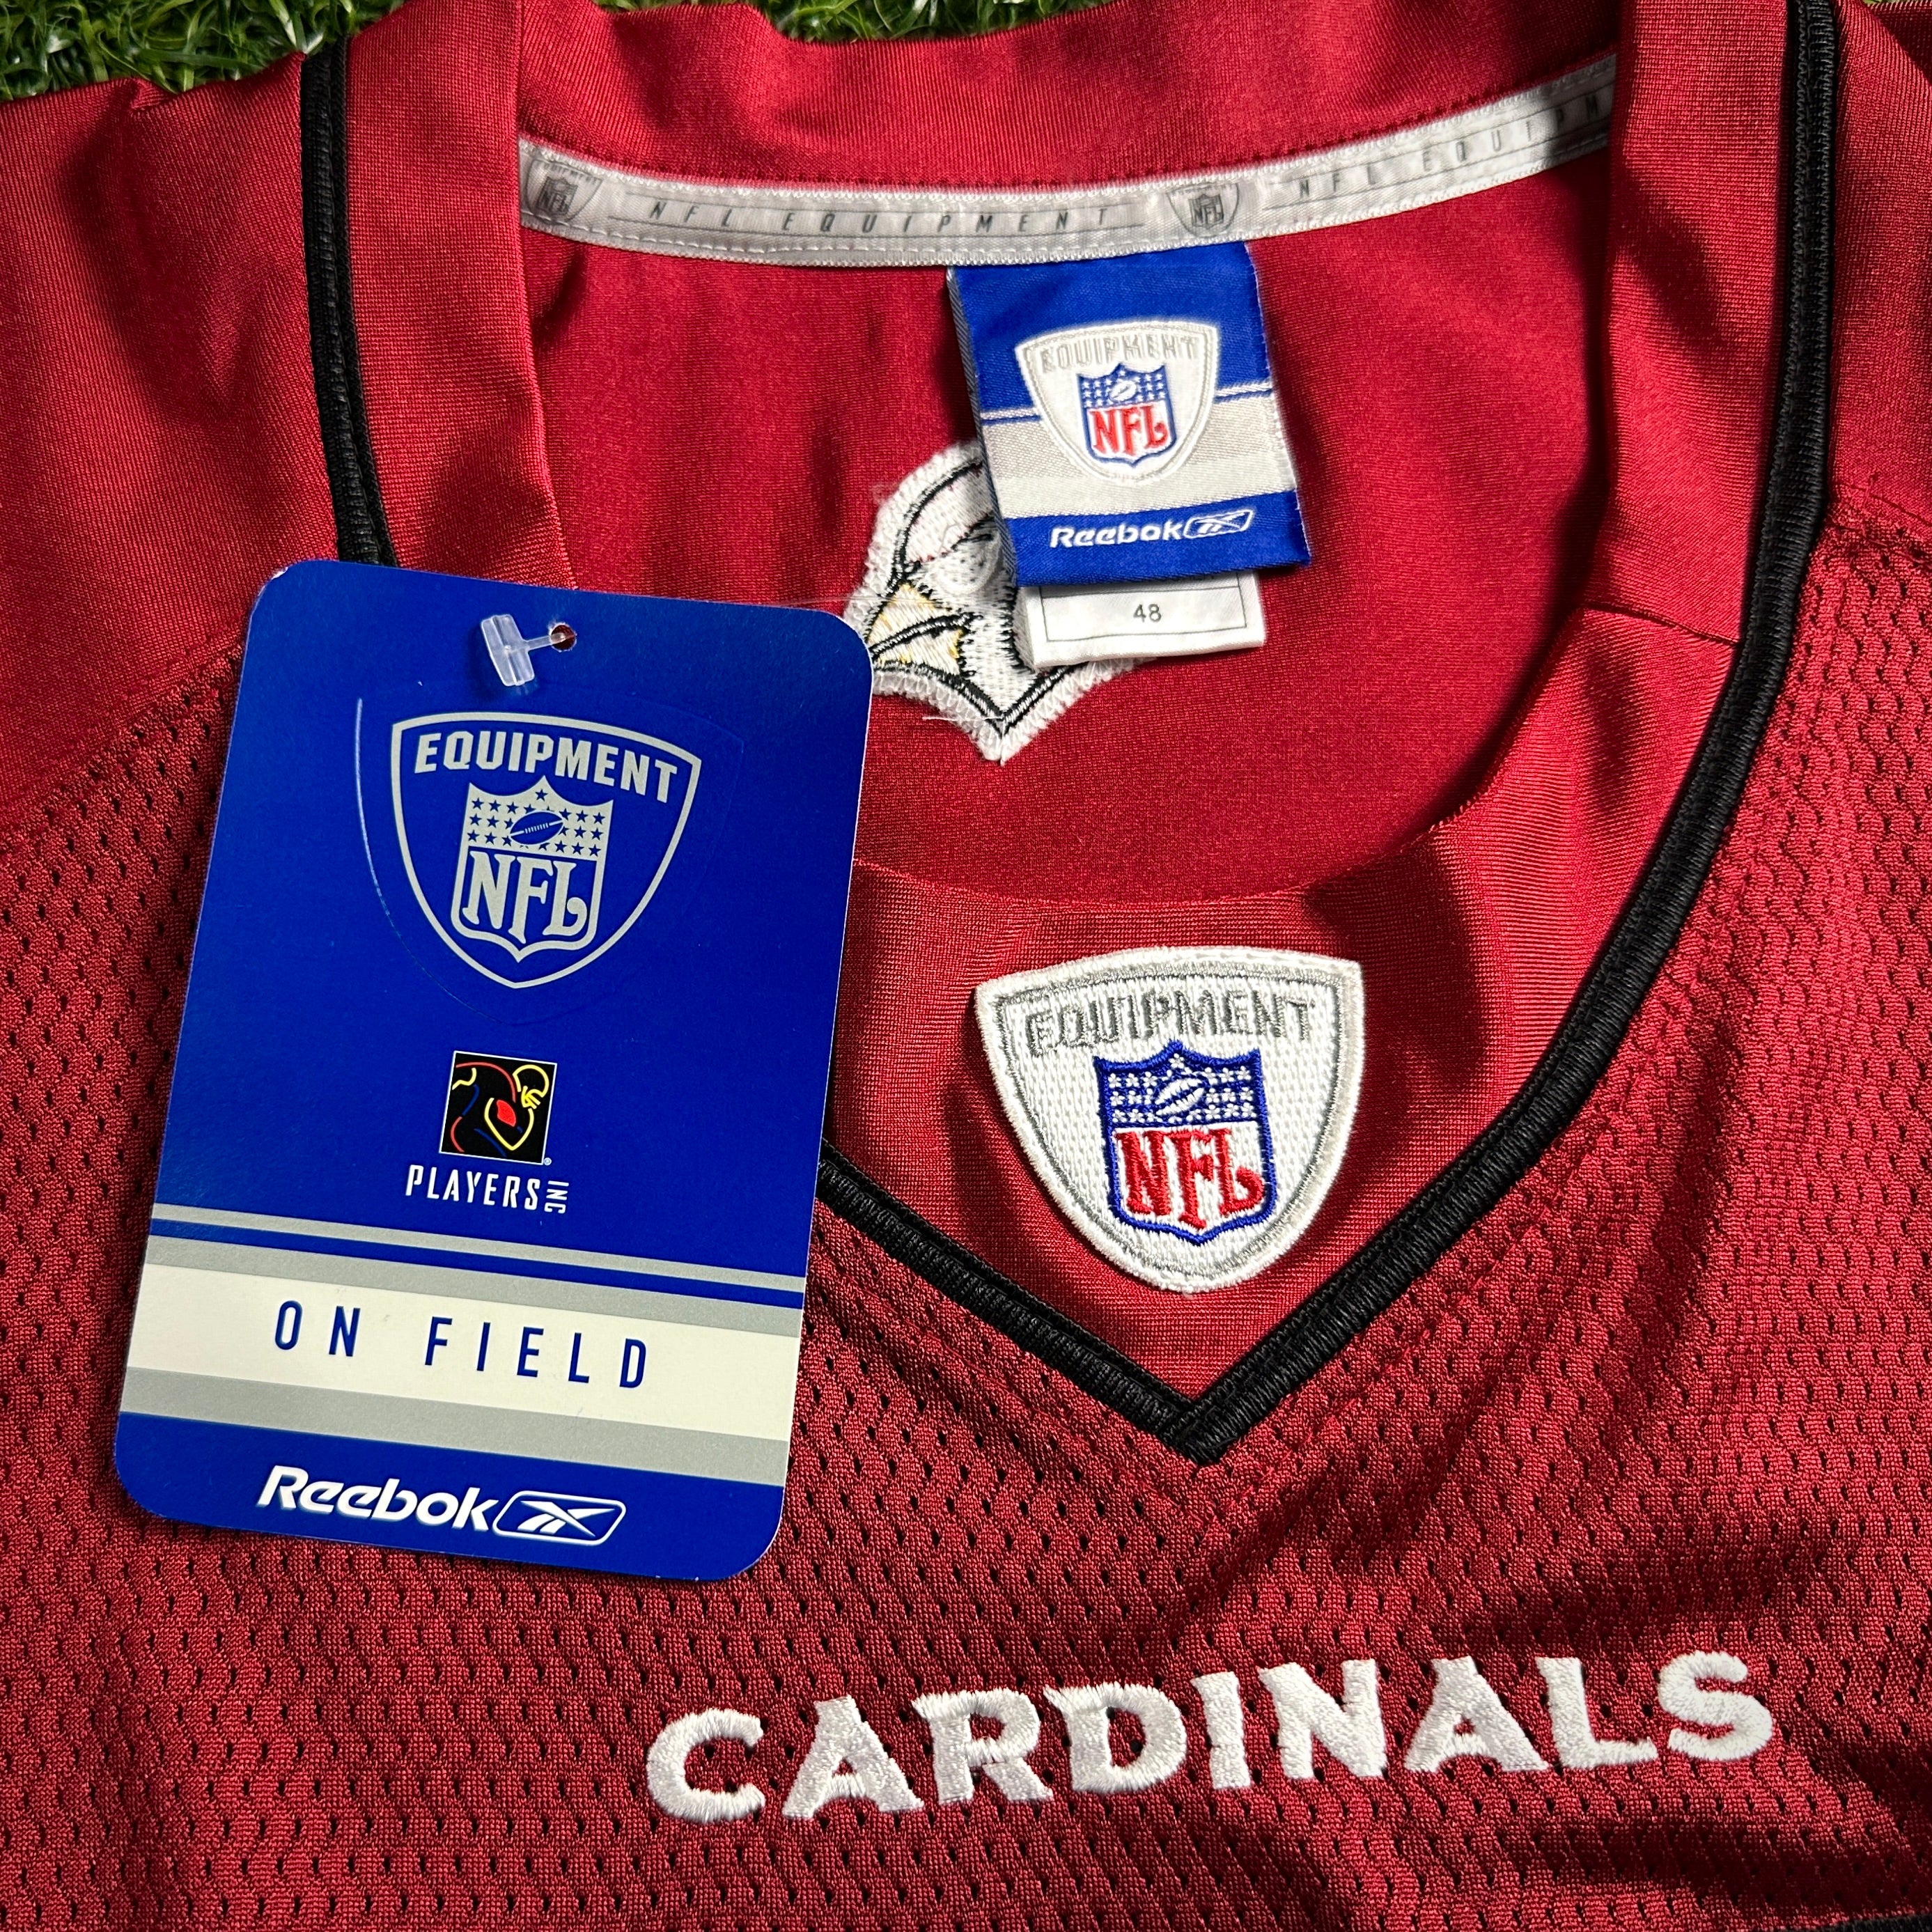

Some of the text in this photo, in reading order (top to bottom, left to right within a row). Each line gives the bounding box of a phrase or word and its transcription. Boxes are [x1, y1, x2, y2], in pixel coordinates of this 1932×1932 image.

[537, 190, 570, 213] NFL
[1299, 162, 1376, 198] NFL
[648, 201, 1109, 233] NFL EQUIPMENT
[1193, 205, 1224, 224] NFL
[1041, 333, 1200, 373] EQUIPMENT
[1089, 403, 1170, 457] NFL
[1050, 518, 1186, 548] Reebok
[1132, 603, 1162, 623] 48
[414, 731, 678, 804] EQUIPMENT
[462, 850, 588, 944] NFL
[1022, 989, 1316, 1058] EQUIPMENT
[405, 1164, 570, 1214] PLAYERS INC
[1116, 1128, 1264, 1229] NFL
[274, 1300, 647, 1389] ON FIELD
[256, 1464, 500, 1532] Reebok
[645, 1649, 1774, 1823] CARDINALS
